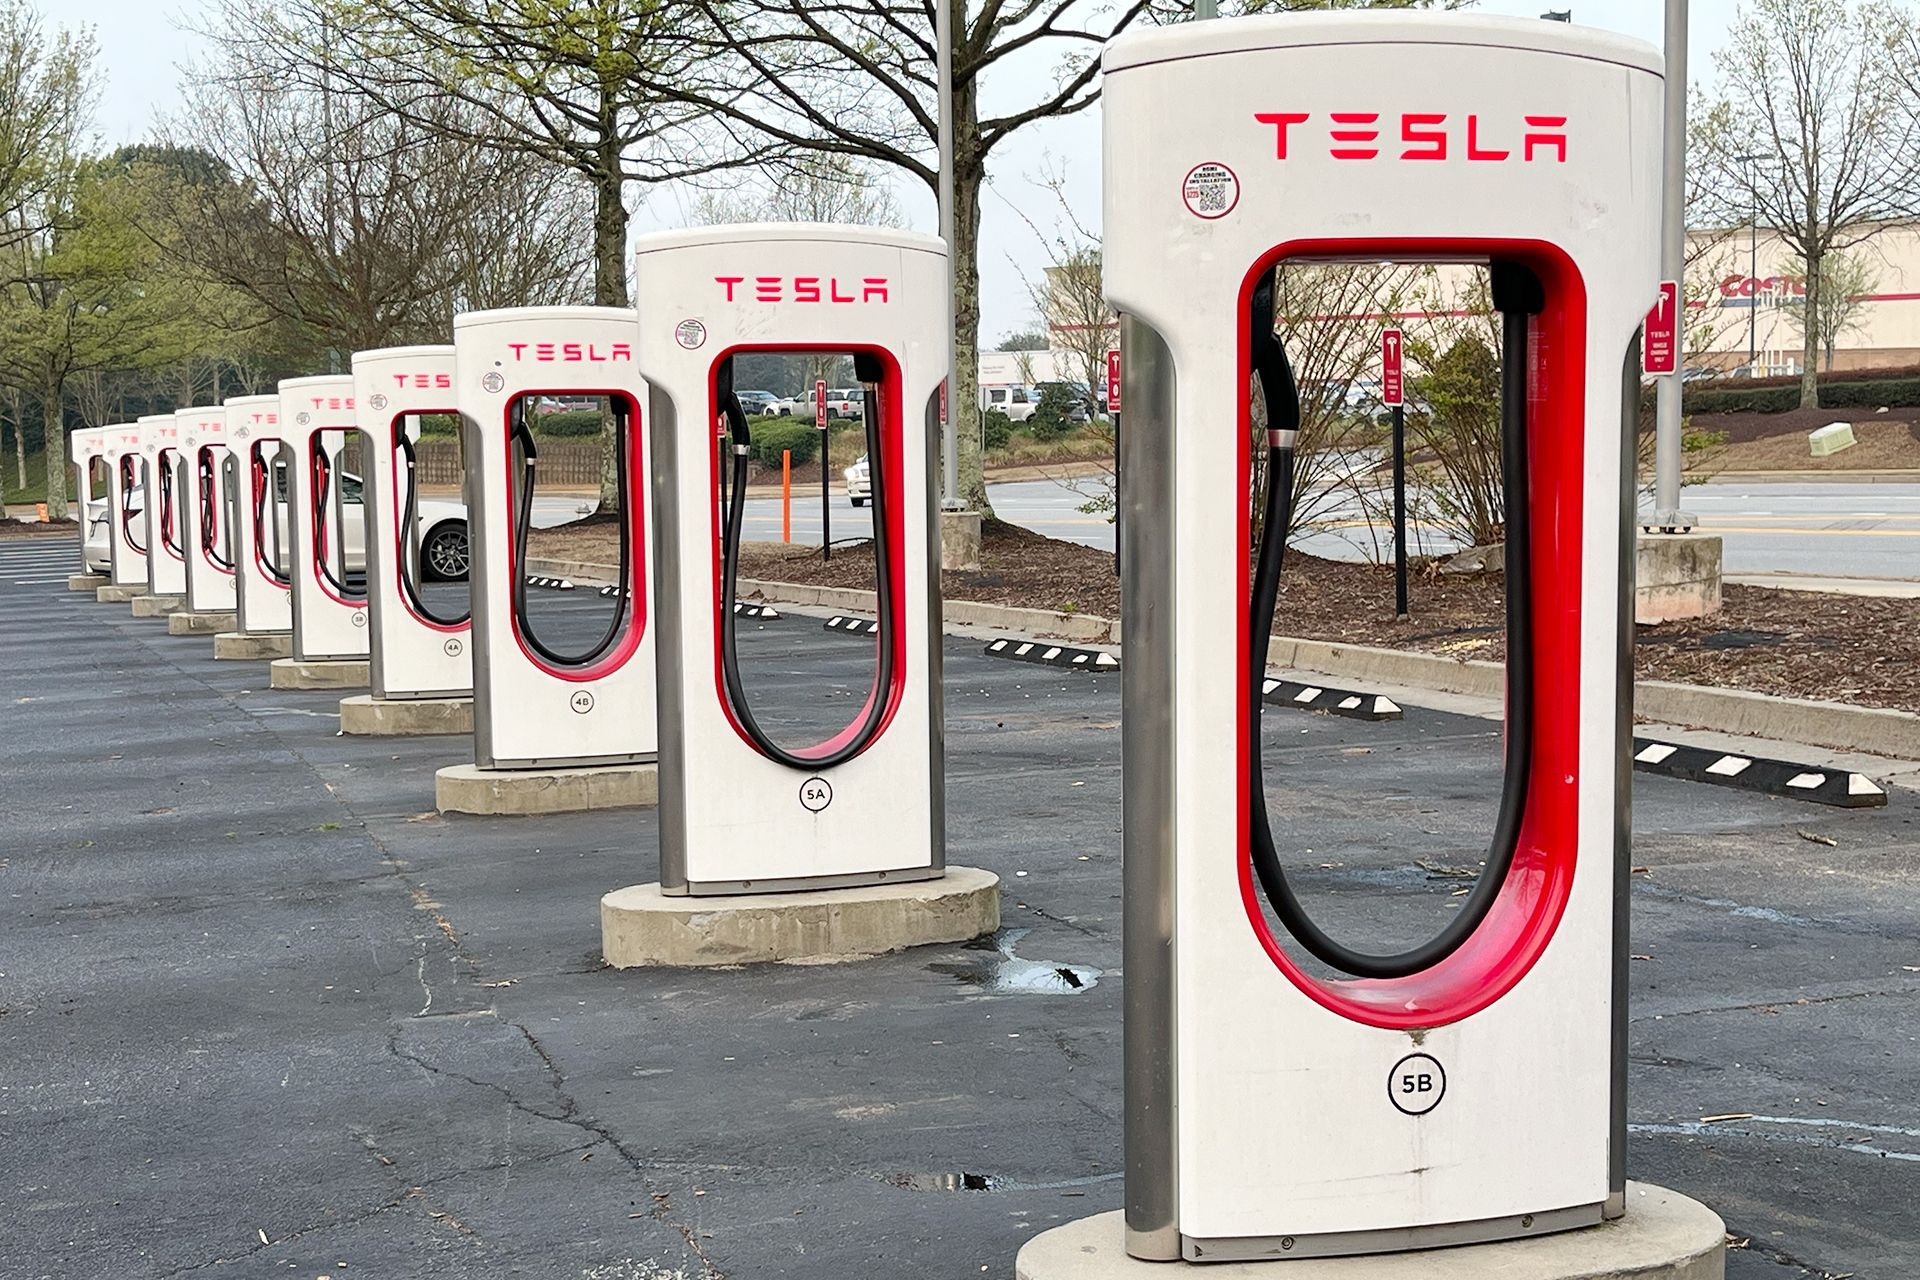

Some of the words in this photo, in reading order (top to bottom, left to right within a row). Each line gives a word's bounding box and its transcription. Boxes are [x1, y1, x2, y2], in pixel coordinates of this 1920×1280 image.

[1253, 112, 1568, 163] TESLA
[714, 277, 889, 303] TESLA
[1720, 274, 1834, 297] COSTC
[507, 343, 631, 361] TESLA
[392, 374, 451, 388] TES
[311, 398, 355, 409] TES
[807, 788, 826, 800] 5A
[1402, 1073, 1433, 1093] 5B
